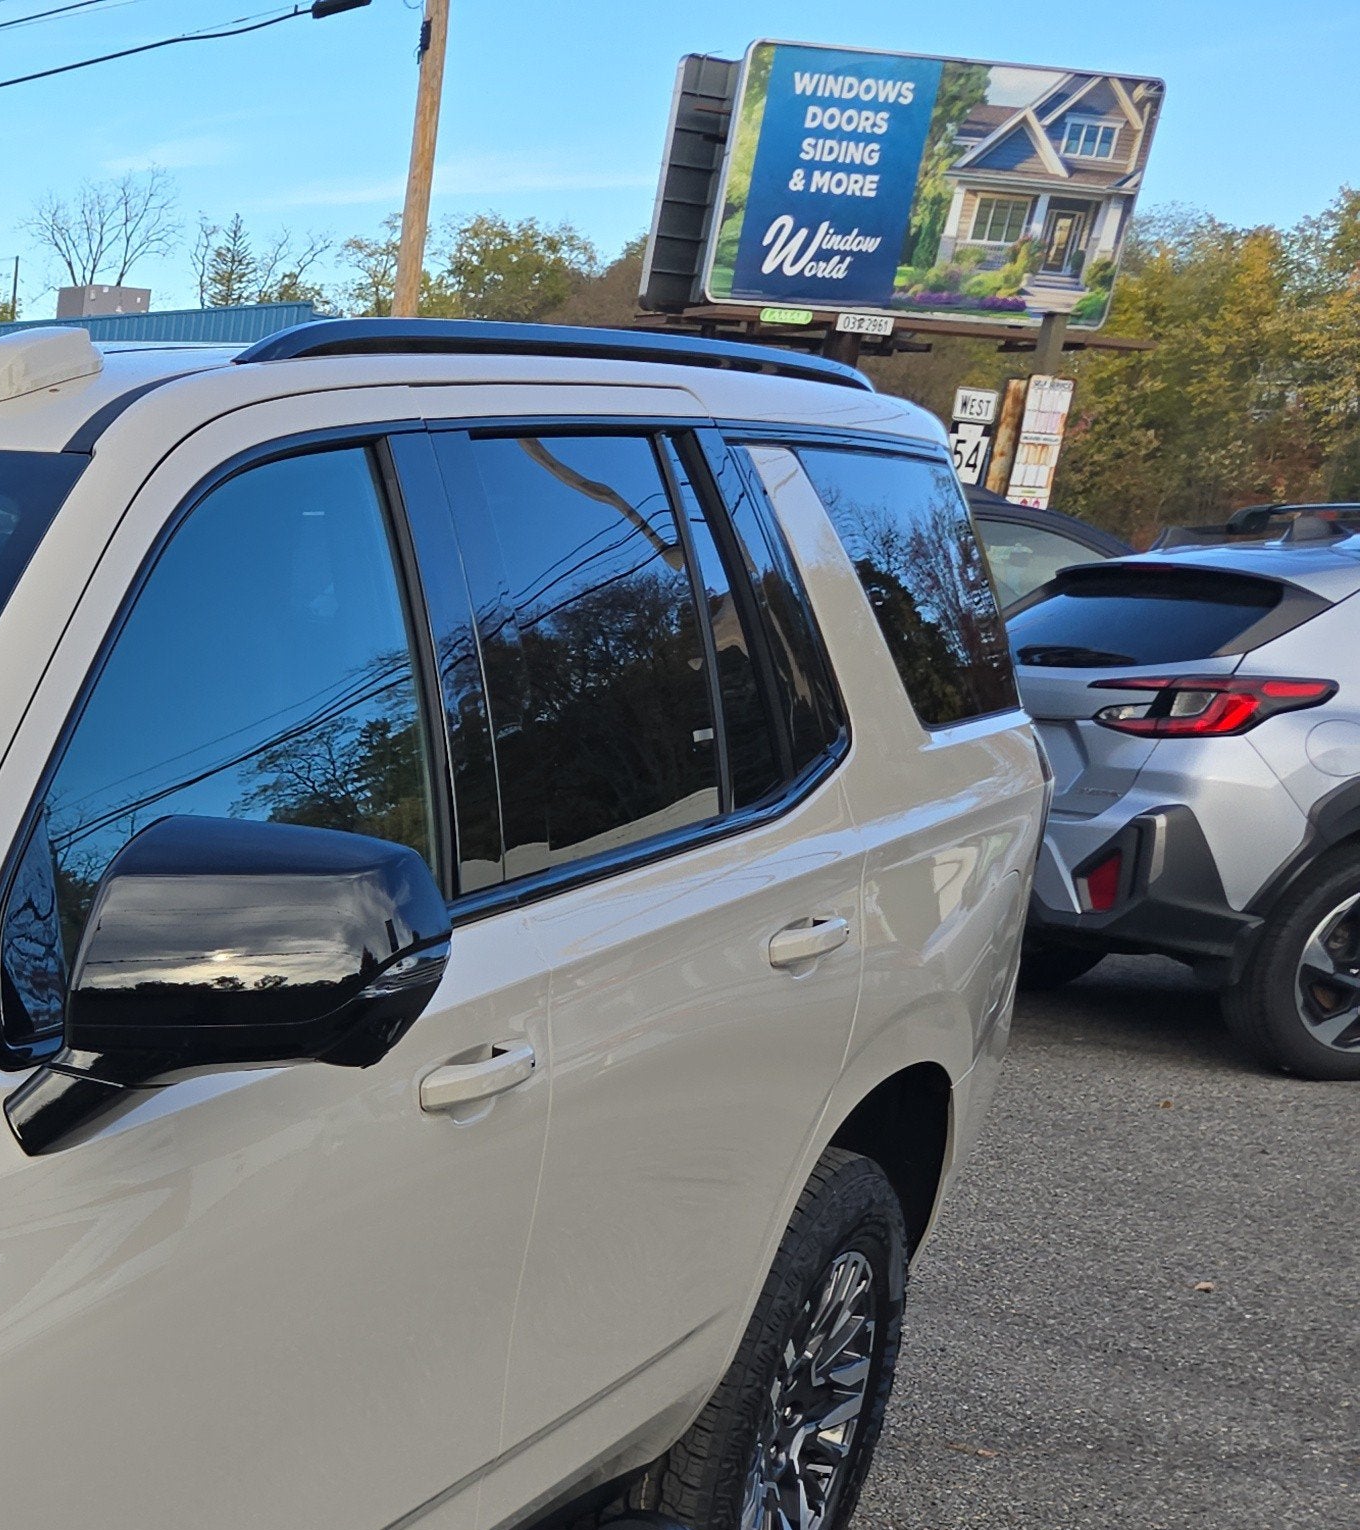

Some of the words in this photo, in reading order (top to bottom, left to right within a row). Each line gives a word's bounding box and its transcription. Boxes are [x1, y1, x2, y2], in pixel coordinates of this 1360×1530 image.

[793, 71, 916, 105] WINDOWS
[804, 105, 890, 135] DOORS
[799, 137, 882, 166] SIDING
[788, 168, 806, 192] &
[810, 170, 880, 197] MORE
[761, 214, 882, 277] Window
[960, 394, 992, 417] WEST
[953, 438, 981, 473] 54
